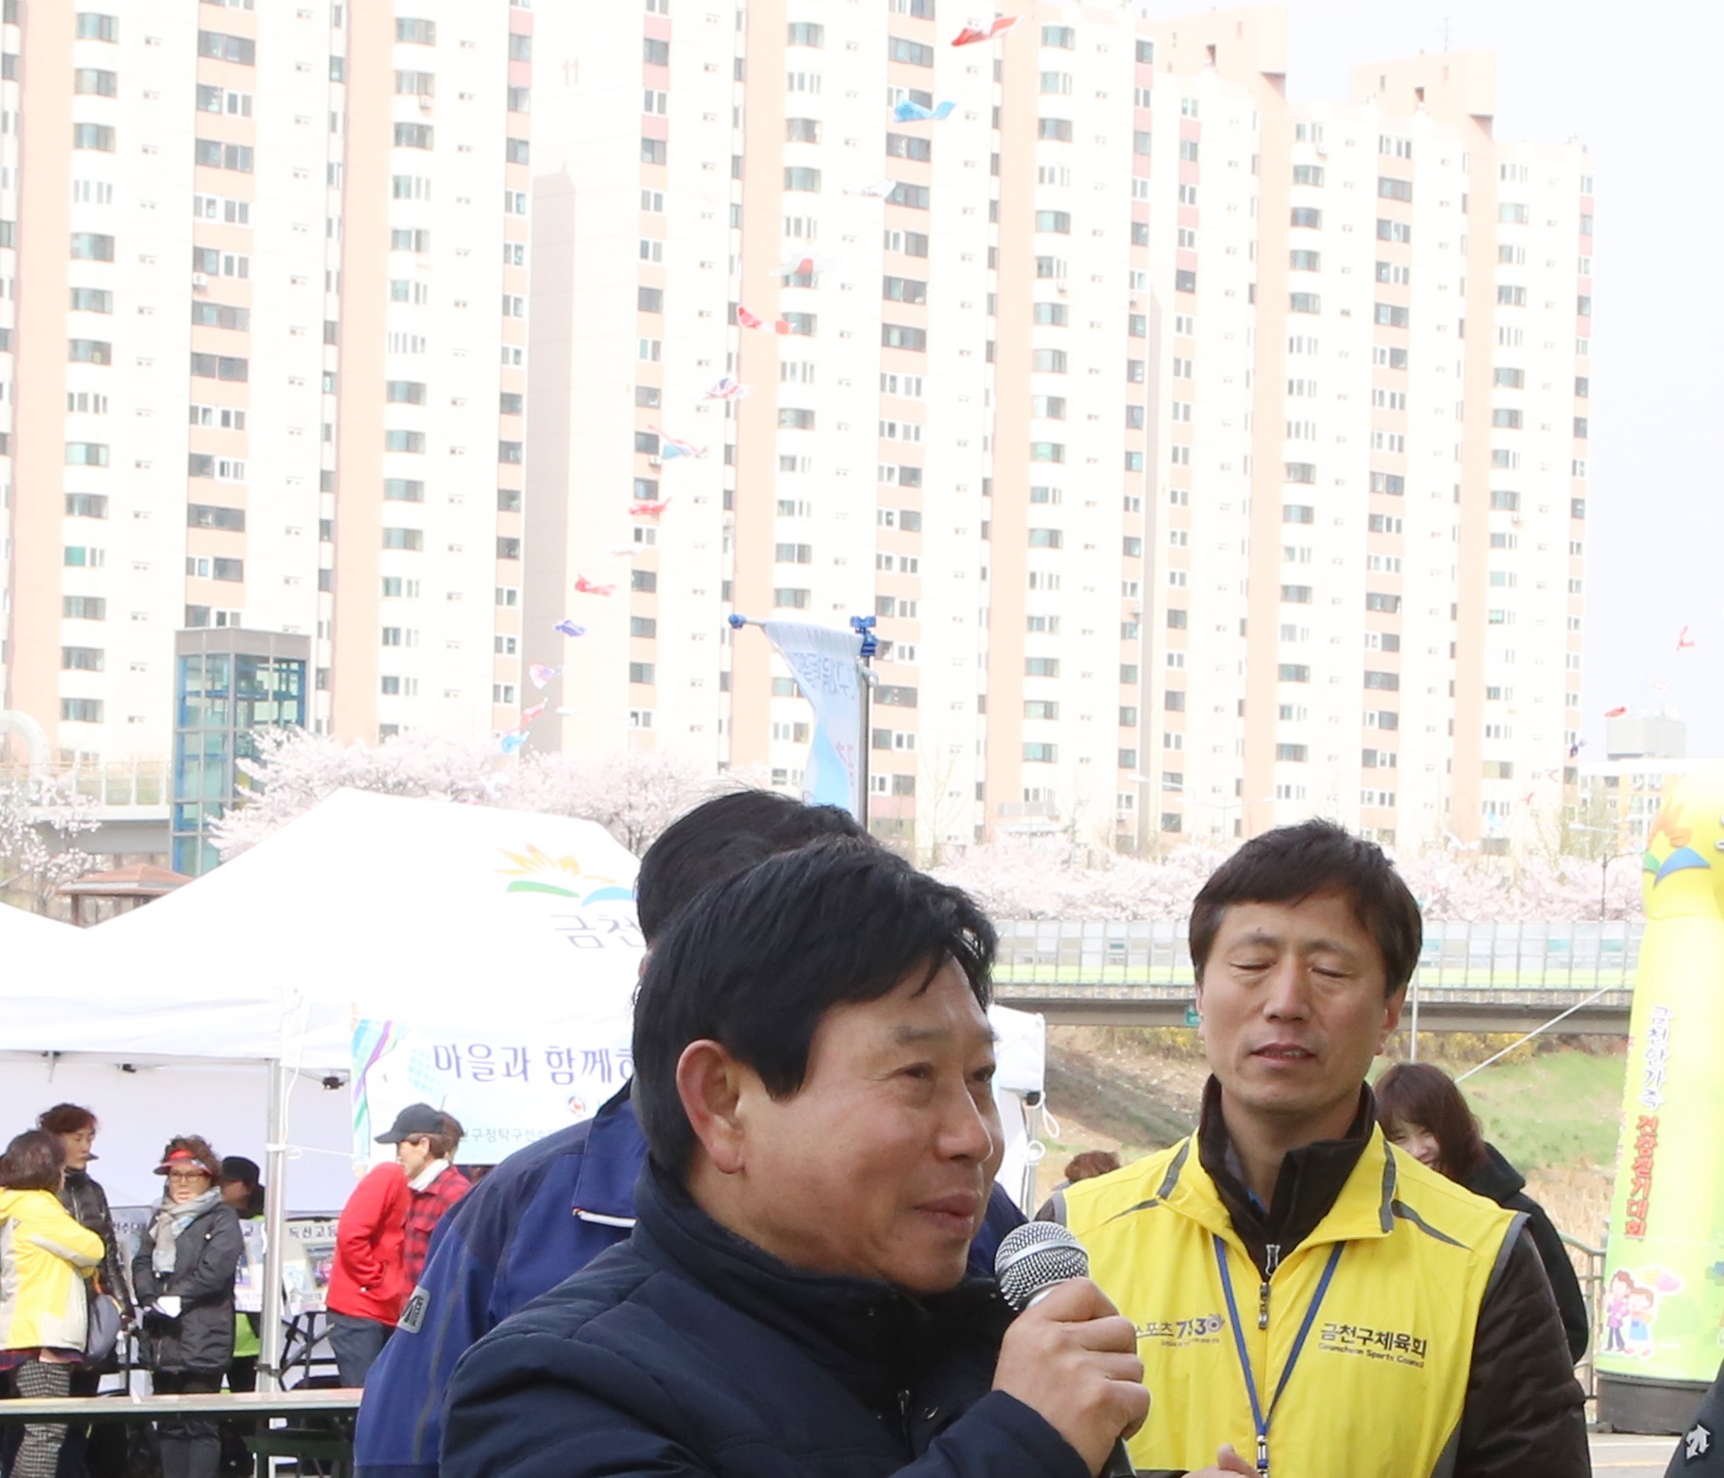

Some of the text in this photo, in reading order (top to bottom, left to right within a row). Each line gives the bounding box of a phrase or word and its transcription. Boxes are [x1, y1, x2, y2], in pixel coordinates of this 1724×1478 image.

[432, 1043, 532, 1084] 마을과
[1624, 1115, 1660, 1241] 건강걷기대회
[1320, 1322, 1427, 1359] 금천구체육회
